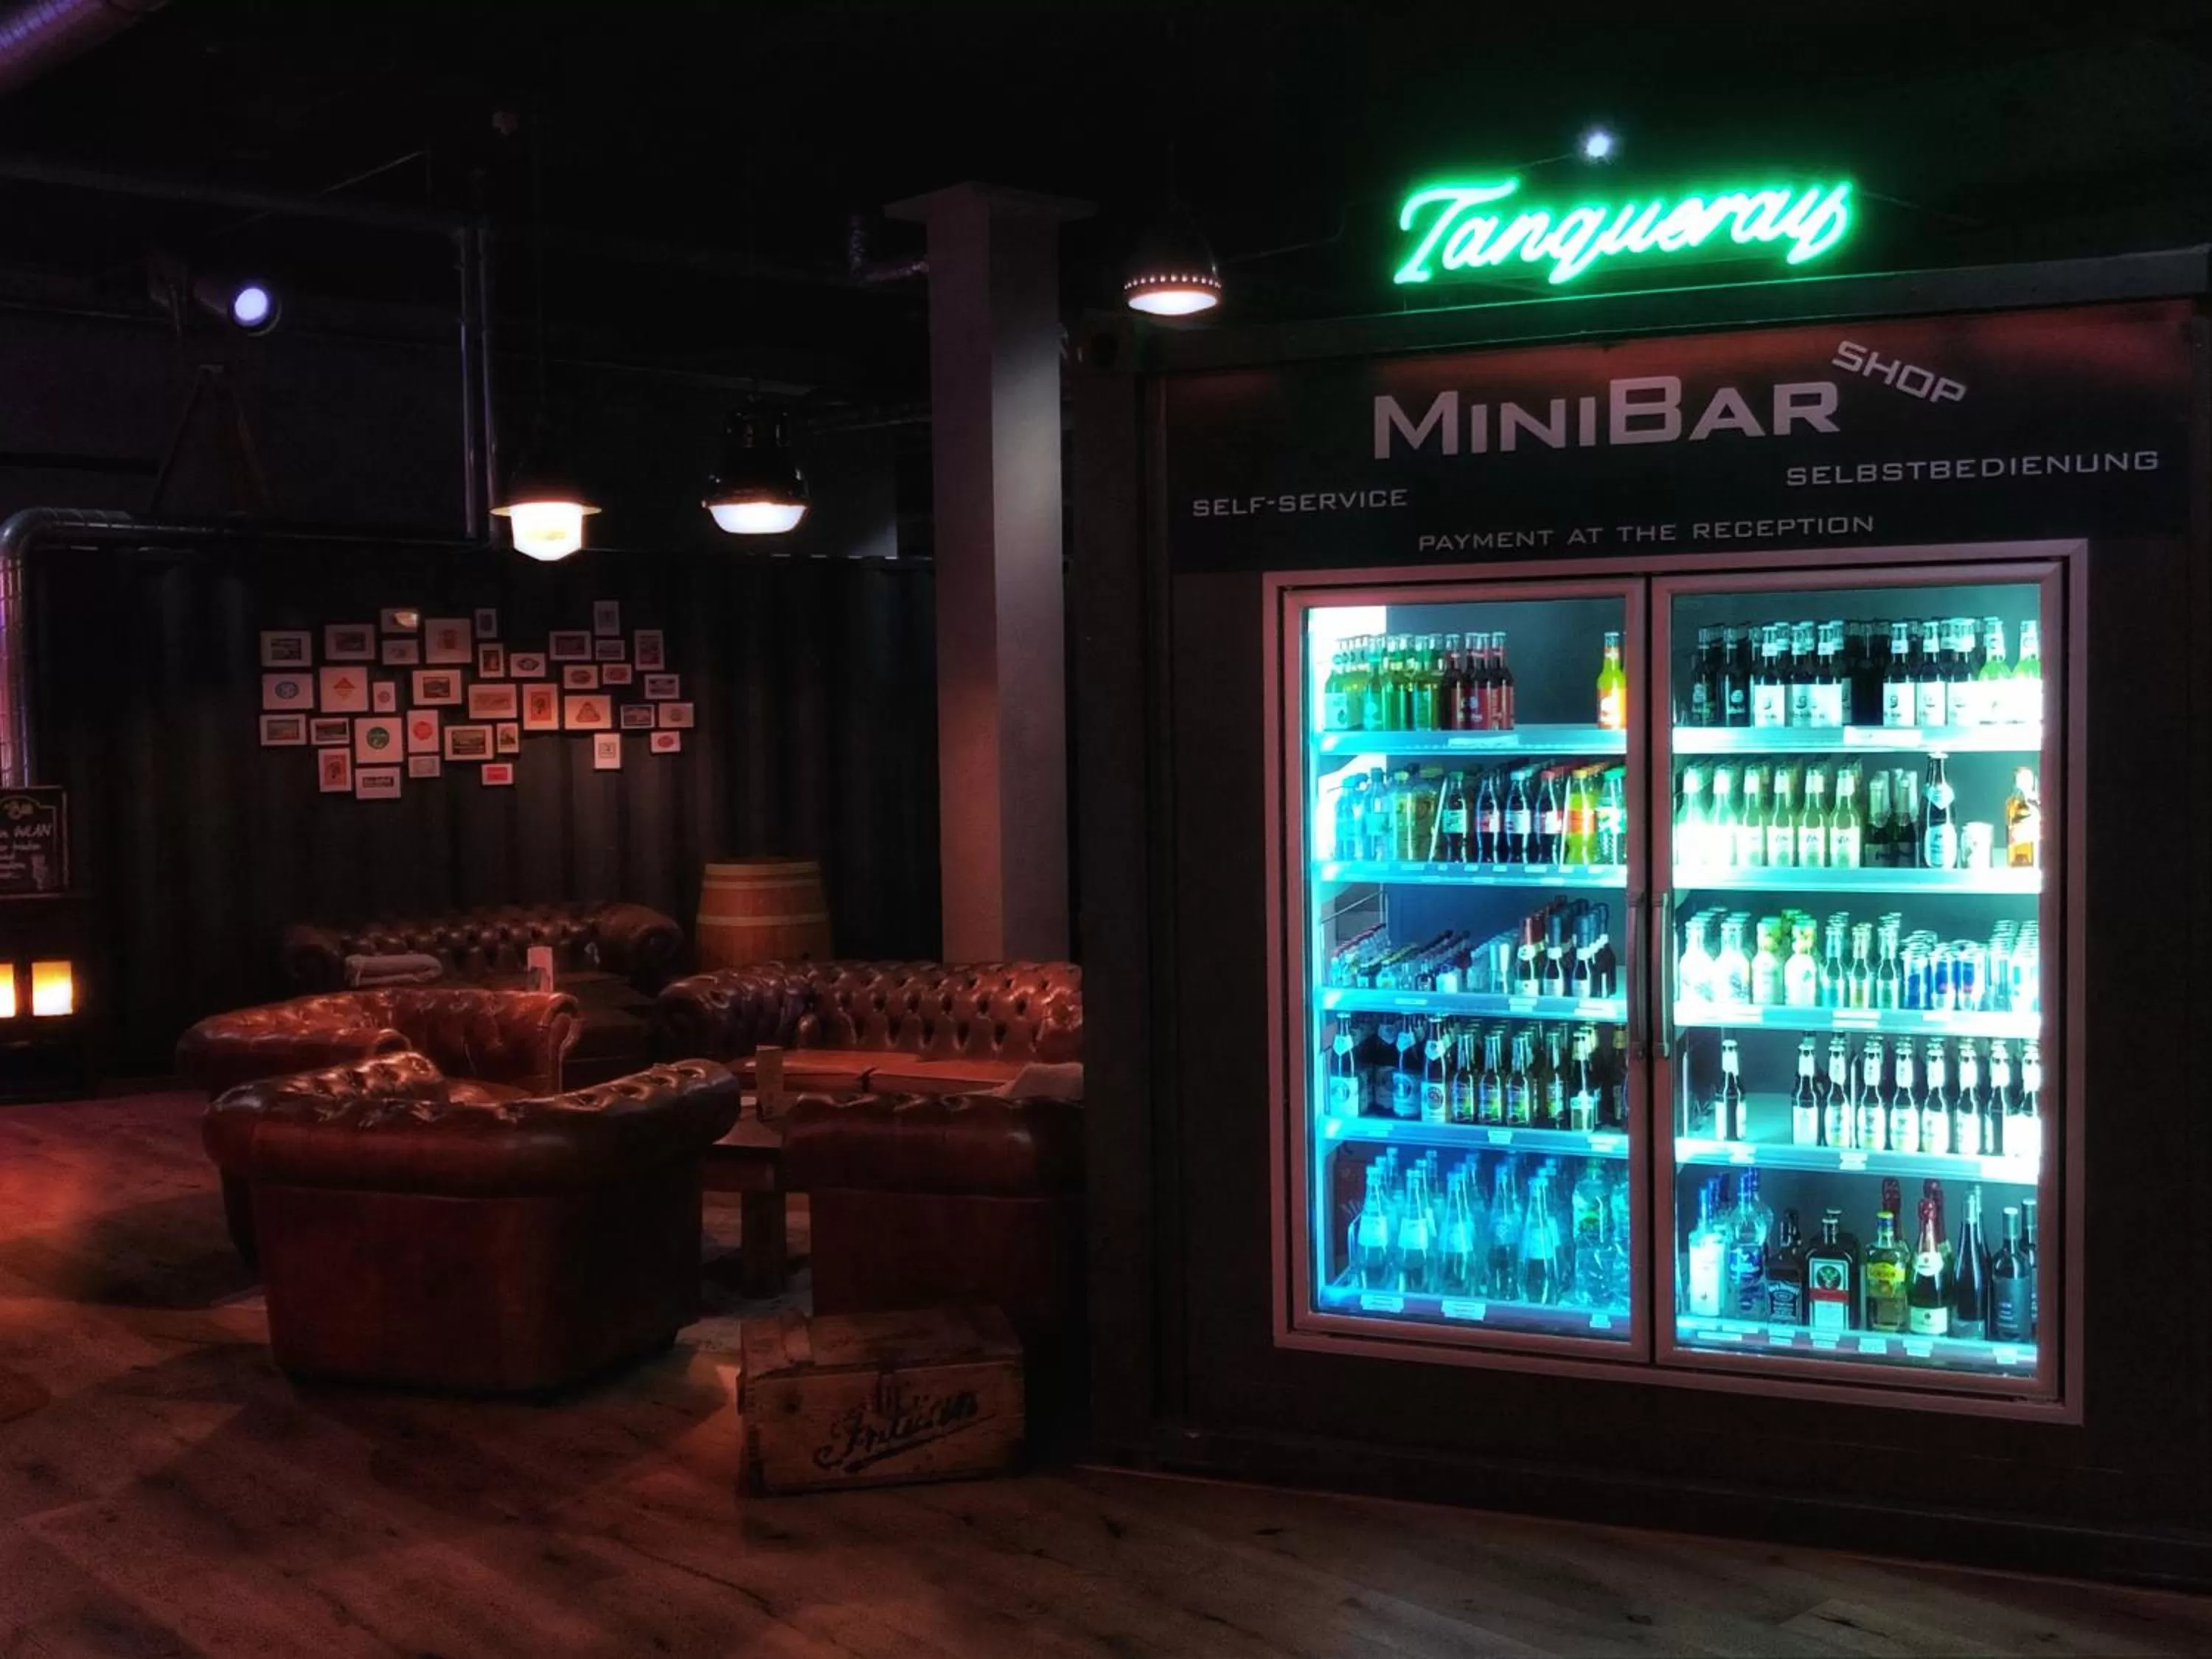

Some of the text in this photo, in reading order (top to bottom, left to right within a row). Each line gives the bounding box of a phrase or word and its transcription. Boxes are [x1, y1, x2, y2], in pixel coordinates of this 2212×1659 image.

[1393, 177, 1854, 285] Tanqueray
[1832, 340, 1966, 404] SHOP
[1786, 451, 2159, 487] SELBSTBEDIENUNG
[1192, 489, 1408, 518] SELF-SERVICE
[1418, 515, 1874, 552] PAYMENT AT THE RECEPTION
